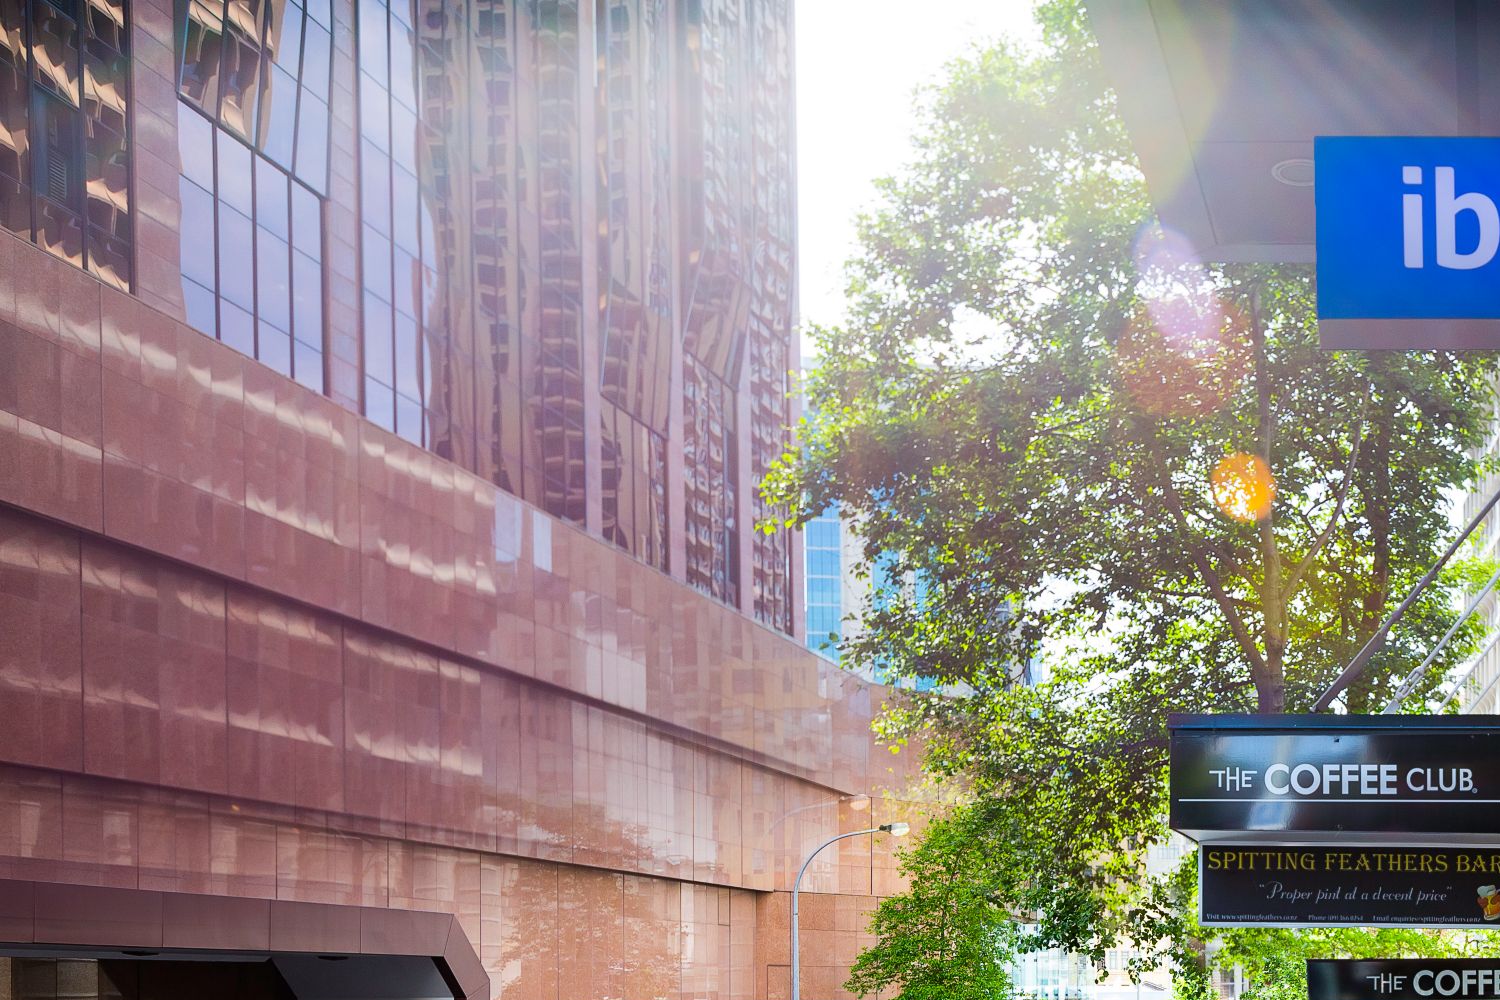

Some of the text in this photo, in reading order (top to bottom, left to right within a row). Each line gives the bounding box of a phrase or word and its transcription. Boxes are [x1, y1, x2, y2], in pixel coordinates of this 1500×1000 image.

[1208, 766, 1258, 792] THE
[1264, 763, 1398, 795] COFFEE
[1207, 851, 1315, 871] SPITTING
[1325, 853, 1448, 873] FEATHERS
[1372, 886, 1413, 902] decent
[1366, 972, 1407, 994] THE
